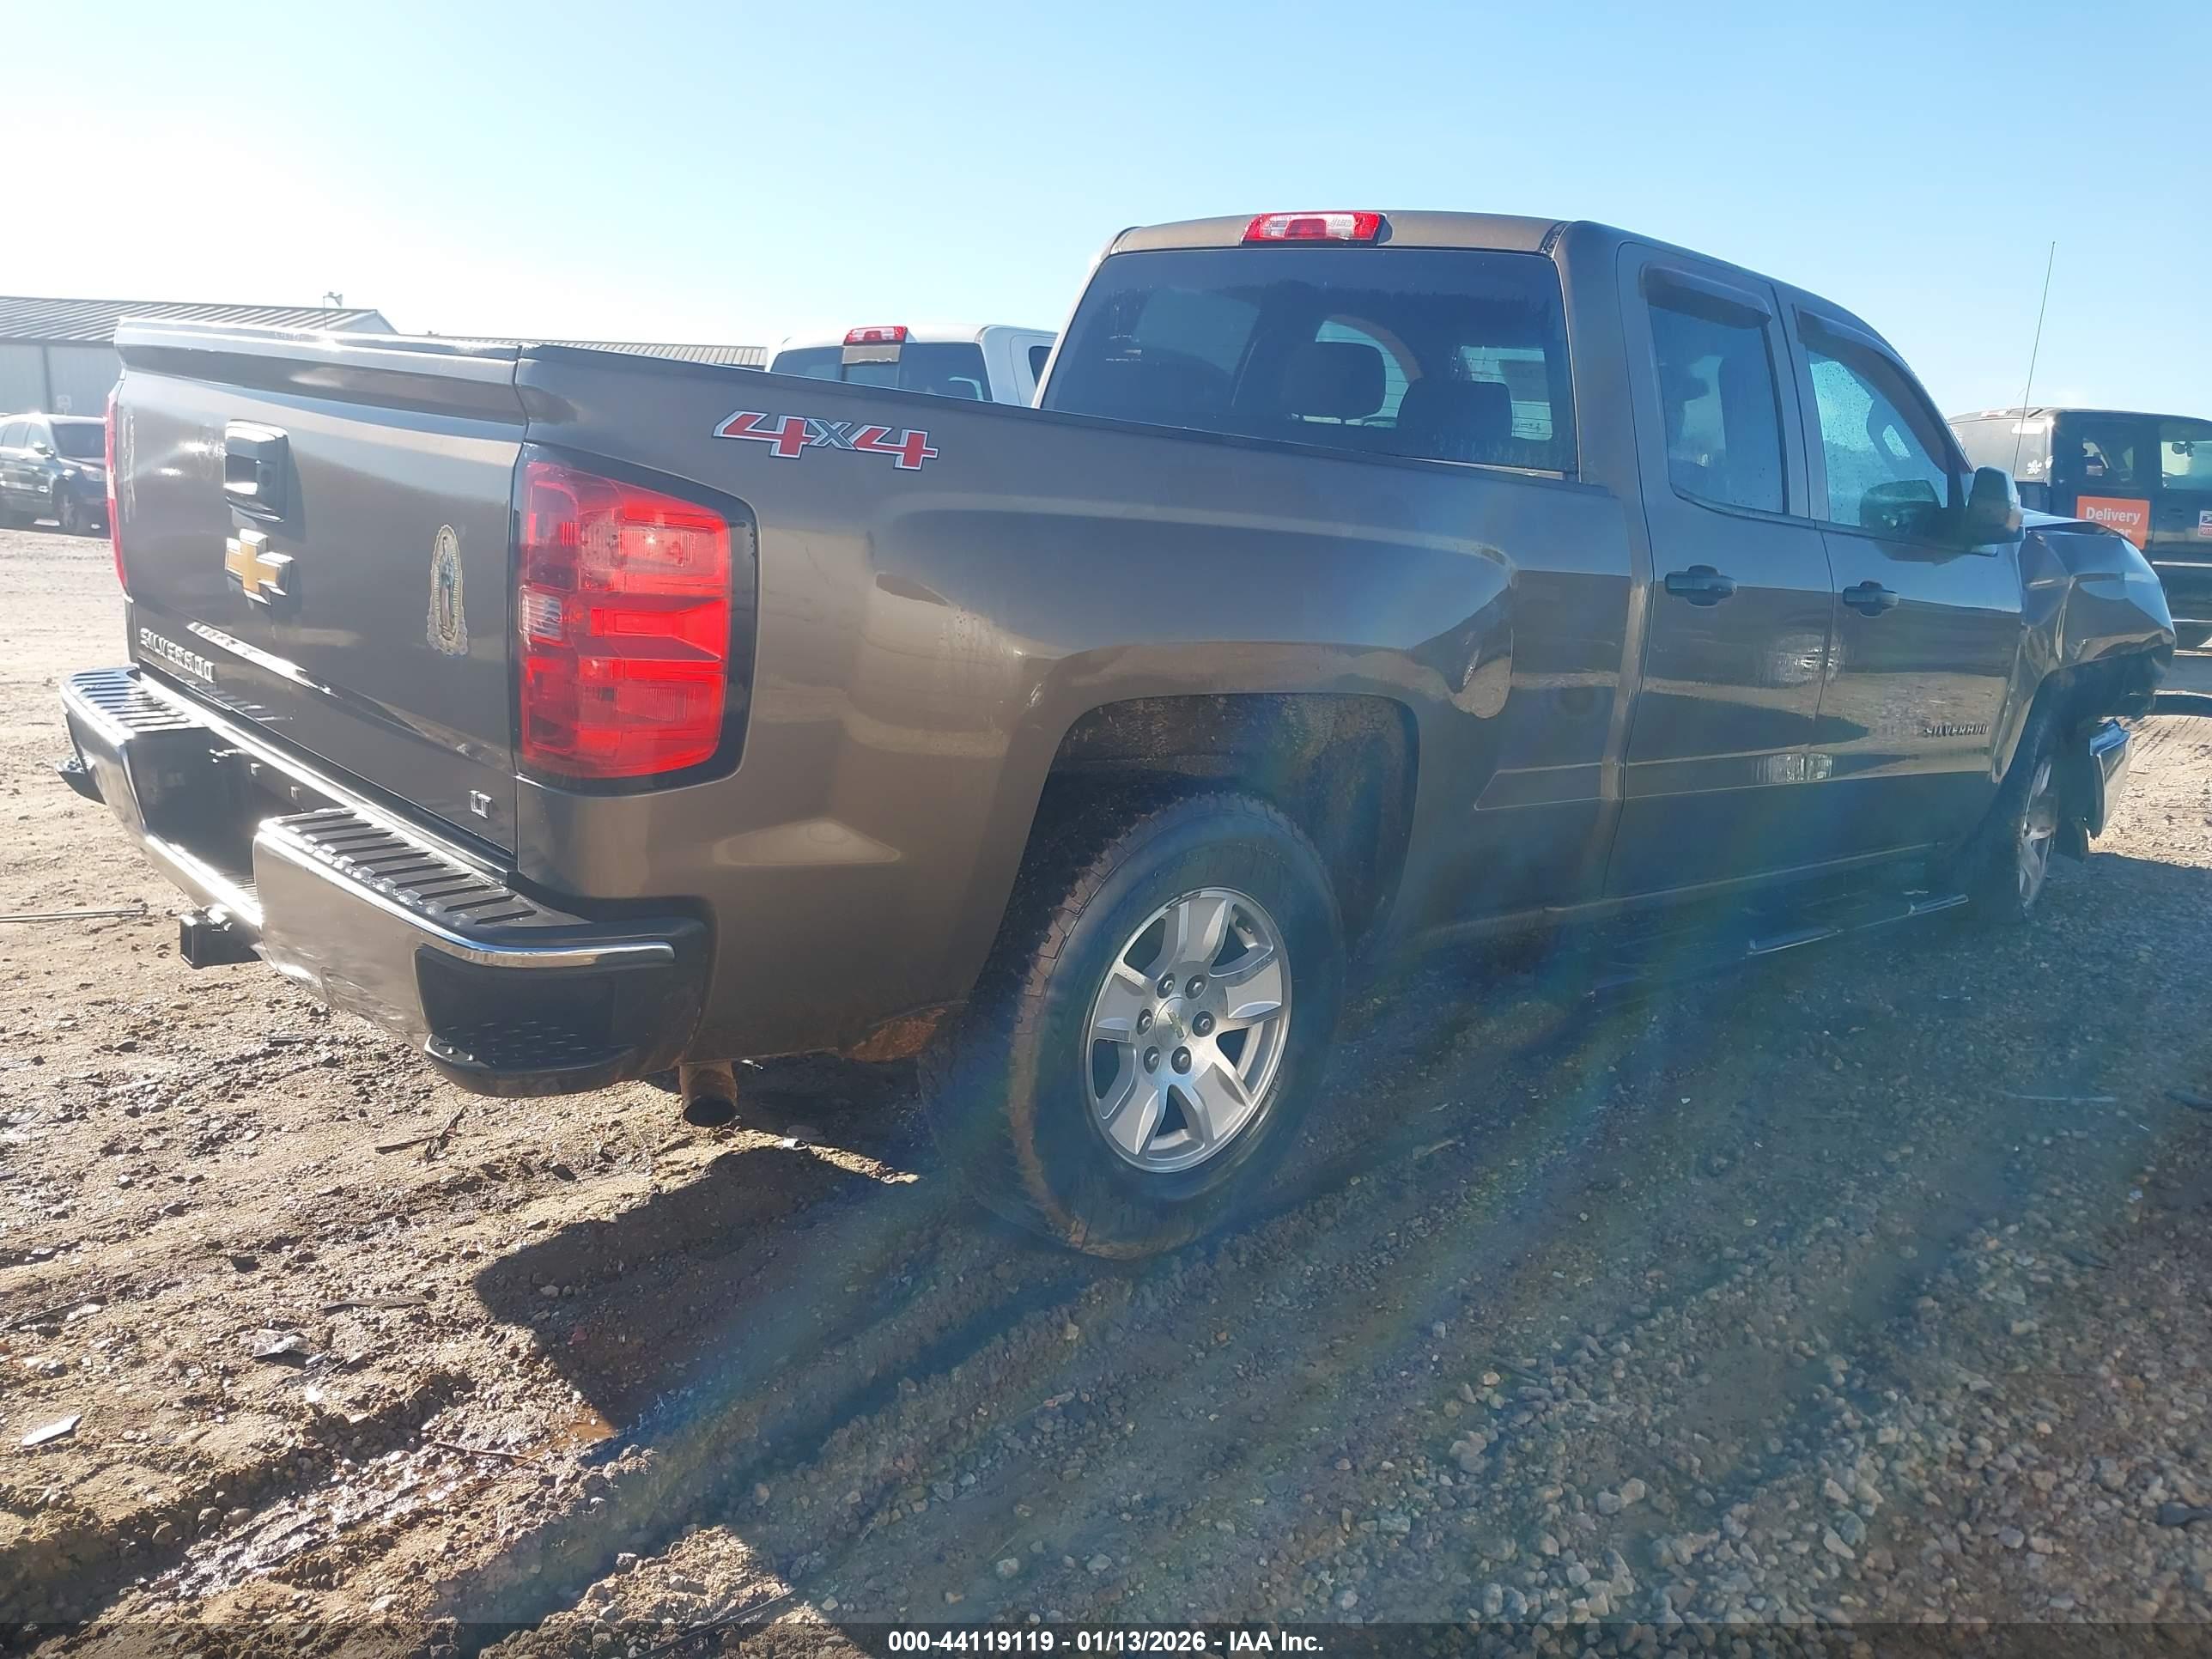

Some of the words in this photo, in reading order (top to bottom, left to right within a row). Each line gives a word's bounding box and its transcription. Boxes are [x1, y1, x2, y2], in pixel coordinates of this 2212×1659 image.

[2086, 507, 2141, 525] Delivery
[140, 628, 215, 684] SILVERADO
[469, 790, 492, 819] LT
